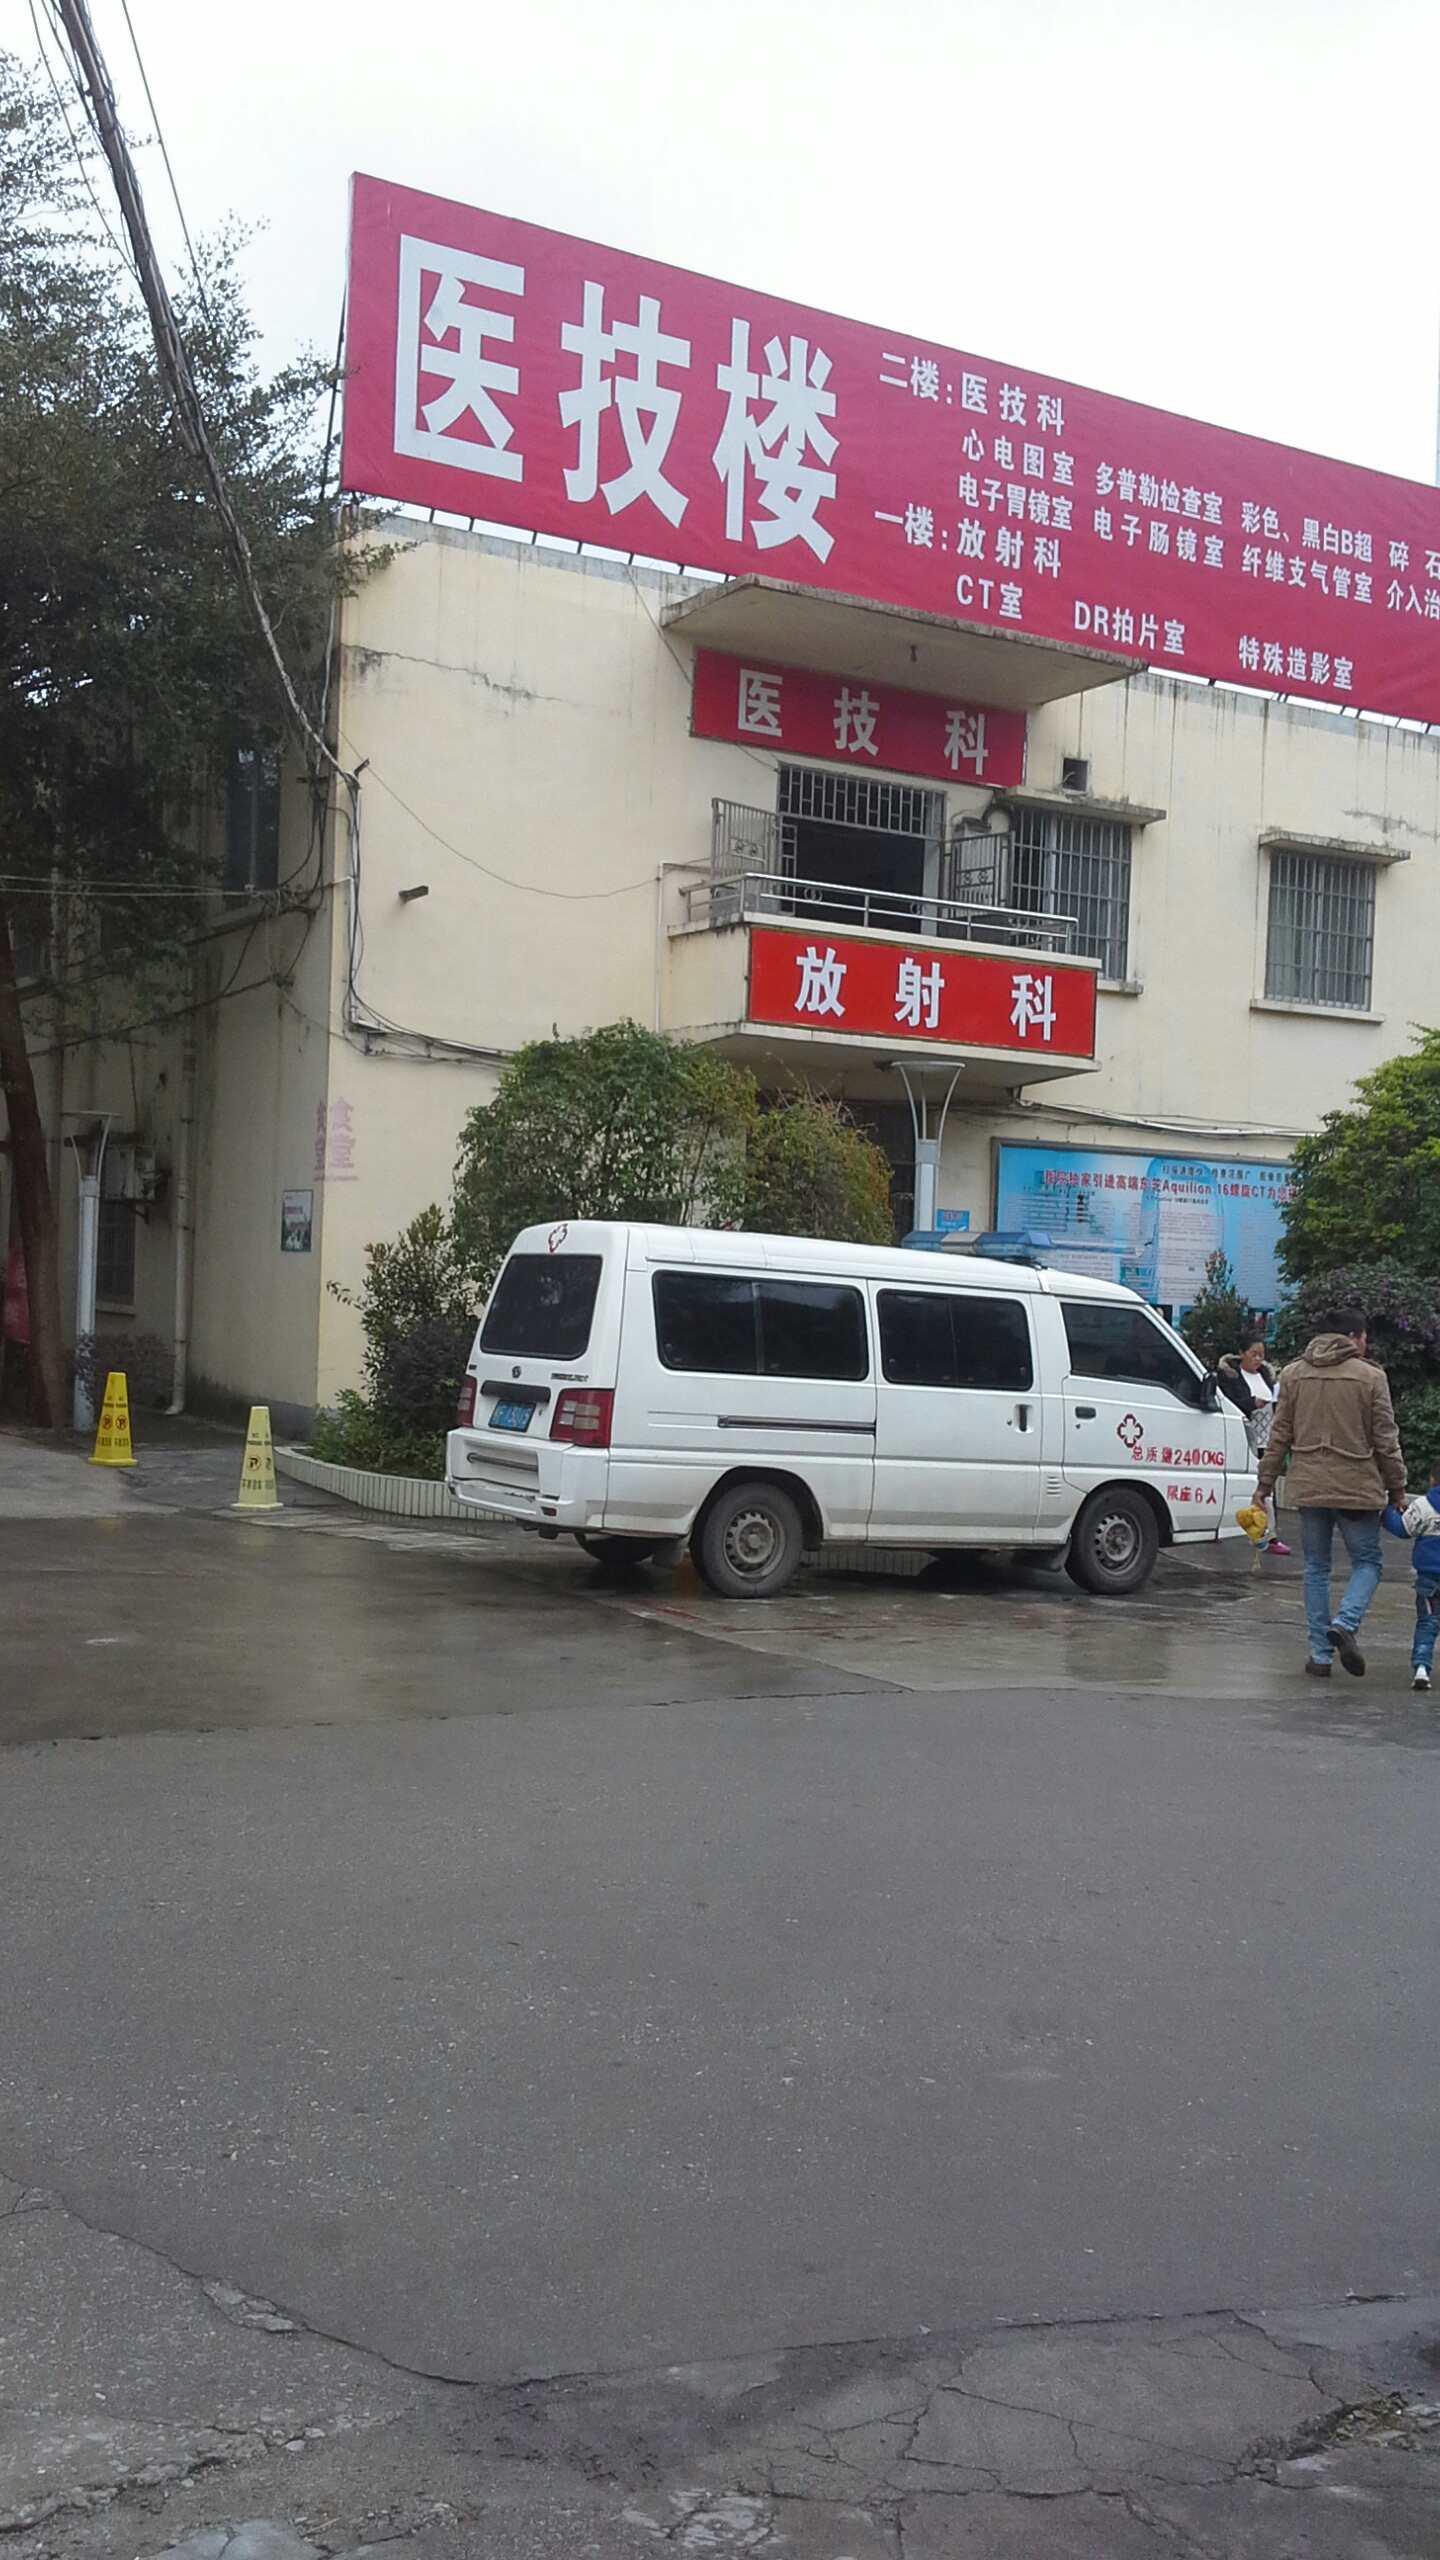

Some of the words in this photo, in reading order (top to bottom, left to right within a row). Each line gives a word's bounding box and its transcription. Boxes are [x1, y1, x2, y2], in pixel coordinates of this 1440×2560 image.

[393, 232, 840, 565] 医技楼
[958, 472, 1073, 531] 电子胃镜室
[1093, 507, 1224, 569] 电子肠镜室
[1241, 544, 1373, 605] 纤维支气管室
[962, 428, 1074, 487] 心电图室
[1095, 462, 1223, 525] 多普勒检查室
[1241, 501, 1373, 563] 彩色、黑白B超
[955, 574, 1023, 620] CT室
[1073, 600, 1186, 656] DR拍片室
[1238, 634, 1354, 691] 特殊造影室
[737, 667, 989, 777] 医技科
[793, 945, 1057, 1042] 放射科
